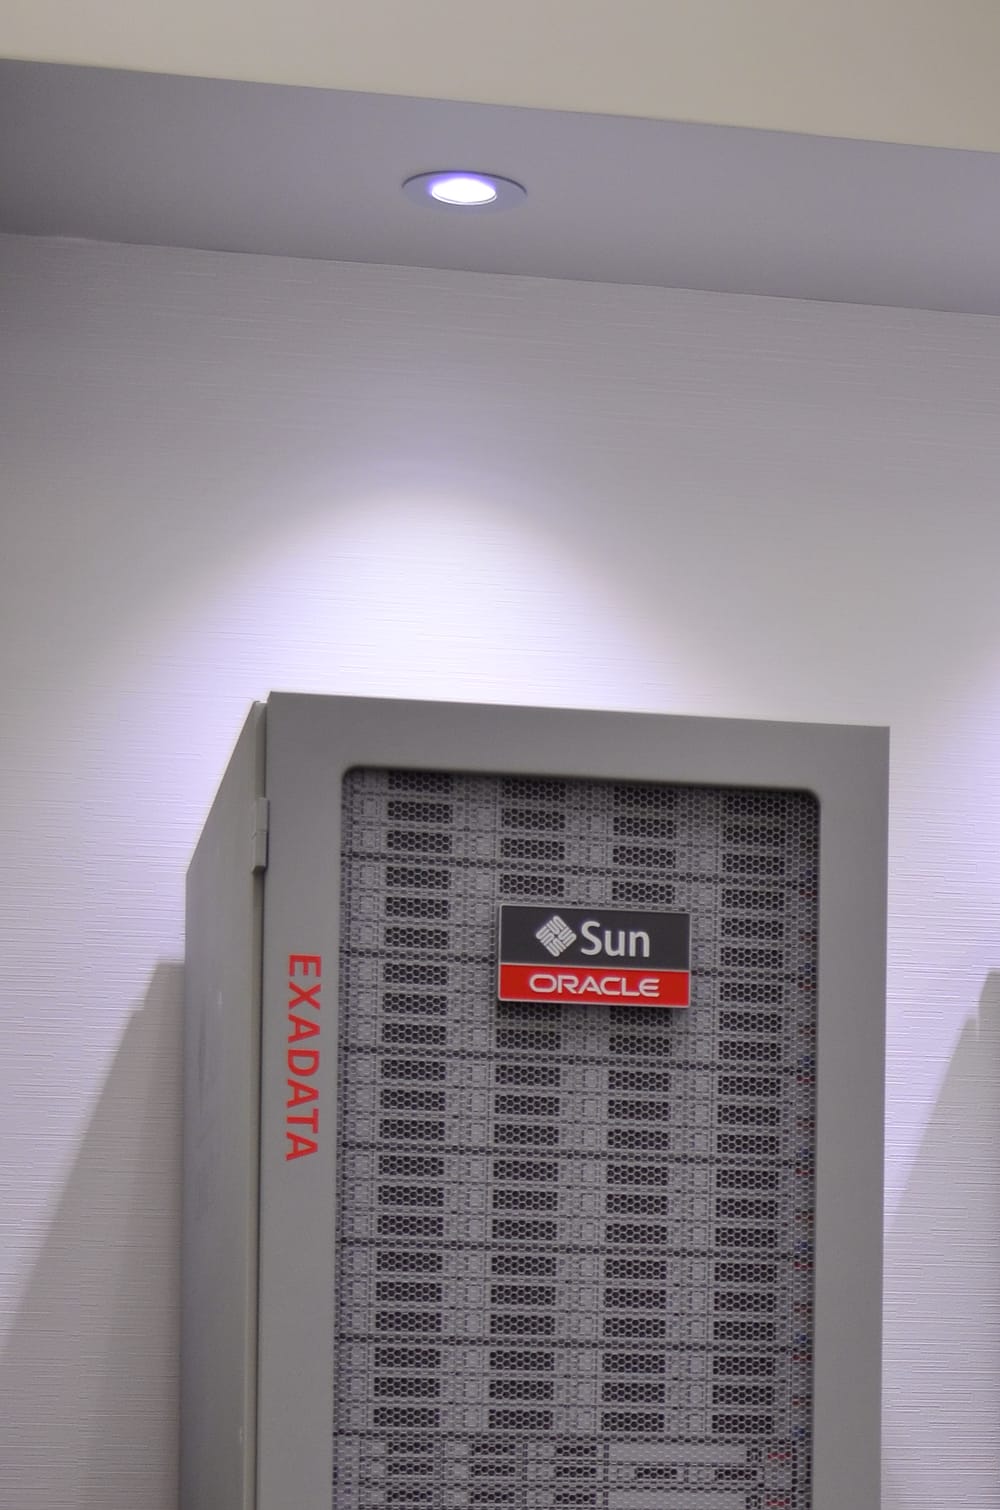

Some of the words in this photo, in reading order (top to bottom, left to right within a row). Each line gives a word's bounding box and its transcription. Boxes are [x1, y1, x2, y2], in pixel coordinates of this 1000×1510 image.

[580, 920, 651, 958] Sun
[529, 973, 661, 998] ORACLE
[284, 952, 323, 1162] EXADATA
